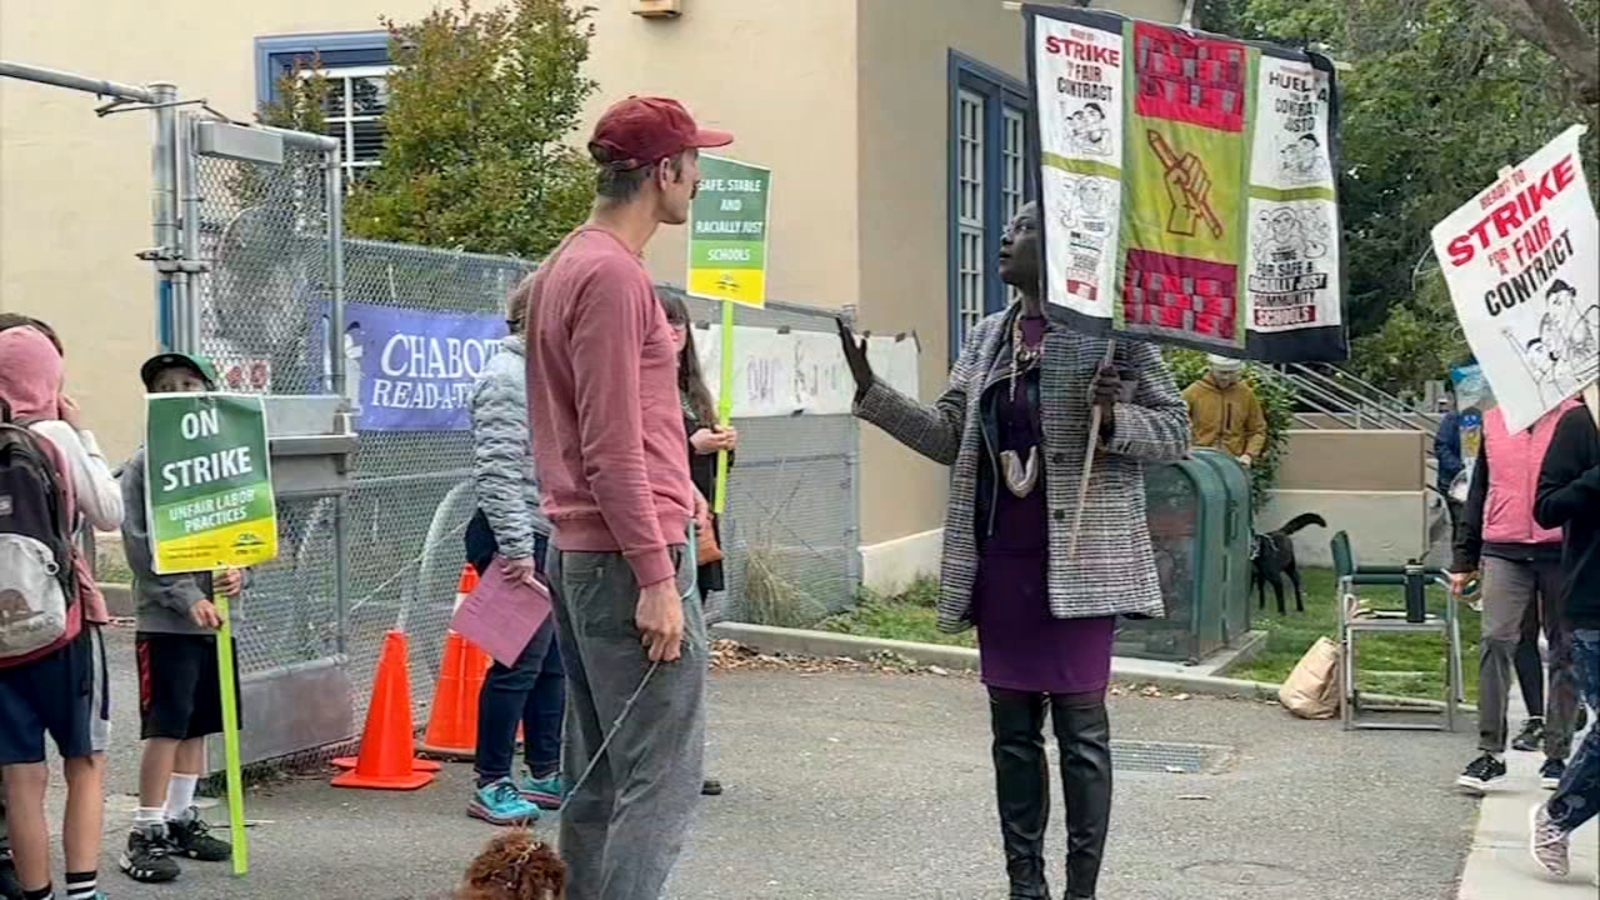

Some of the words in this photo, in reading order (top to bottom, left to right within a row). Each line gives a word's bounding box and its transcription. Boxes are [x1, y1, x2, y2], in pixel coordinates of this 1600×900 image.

[1045, 35, 1120, 68] STRIKE
[1075, 64, 1102, 82] FAIR
[1269, 71, 1328, 102] HUELA
[1057, 76, 1113, 102] CONTRACT
[1275, 98, 1319, 117] CONTRAT
[698, 179, 726, 192] SAFE,
[727, 179, 761, 192] STABLE
[1479, 180, 1511, 210] READY
[1511, 168, 1526, 186] TO
[720, 199, 742, 211] AND
[1447, 152, 1576, 267] STRIKE
[695, 220, 740, 233] RACIALLY
[742, 221, 763, 233] JUST
[707, 249, 750, 260] SCHOOLS
[1488, 248, 1510, 267] FOR
[1512, 215, 1552, 267] FAIR
[1484, 228, 1574, 317] CONTRACT
[1499, 263, 1509, 276] A
[1256, 306, 1310, 325] SCHOOLS
[371, 378, 473, 410] READ-A-T
[181, 408, 220, 440] ON
[162, 446, 253, 492] STRIKE
[169, 499, 215, 521] UNFAIR
[216, 489, 255, 510] LABOR
[184, 507, 247, 532] PRACTICES
